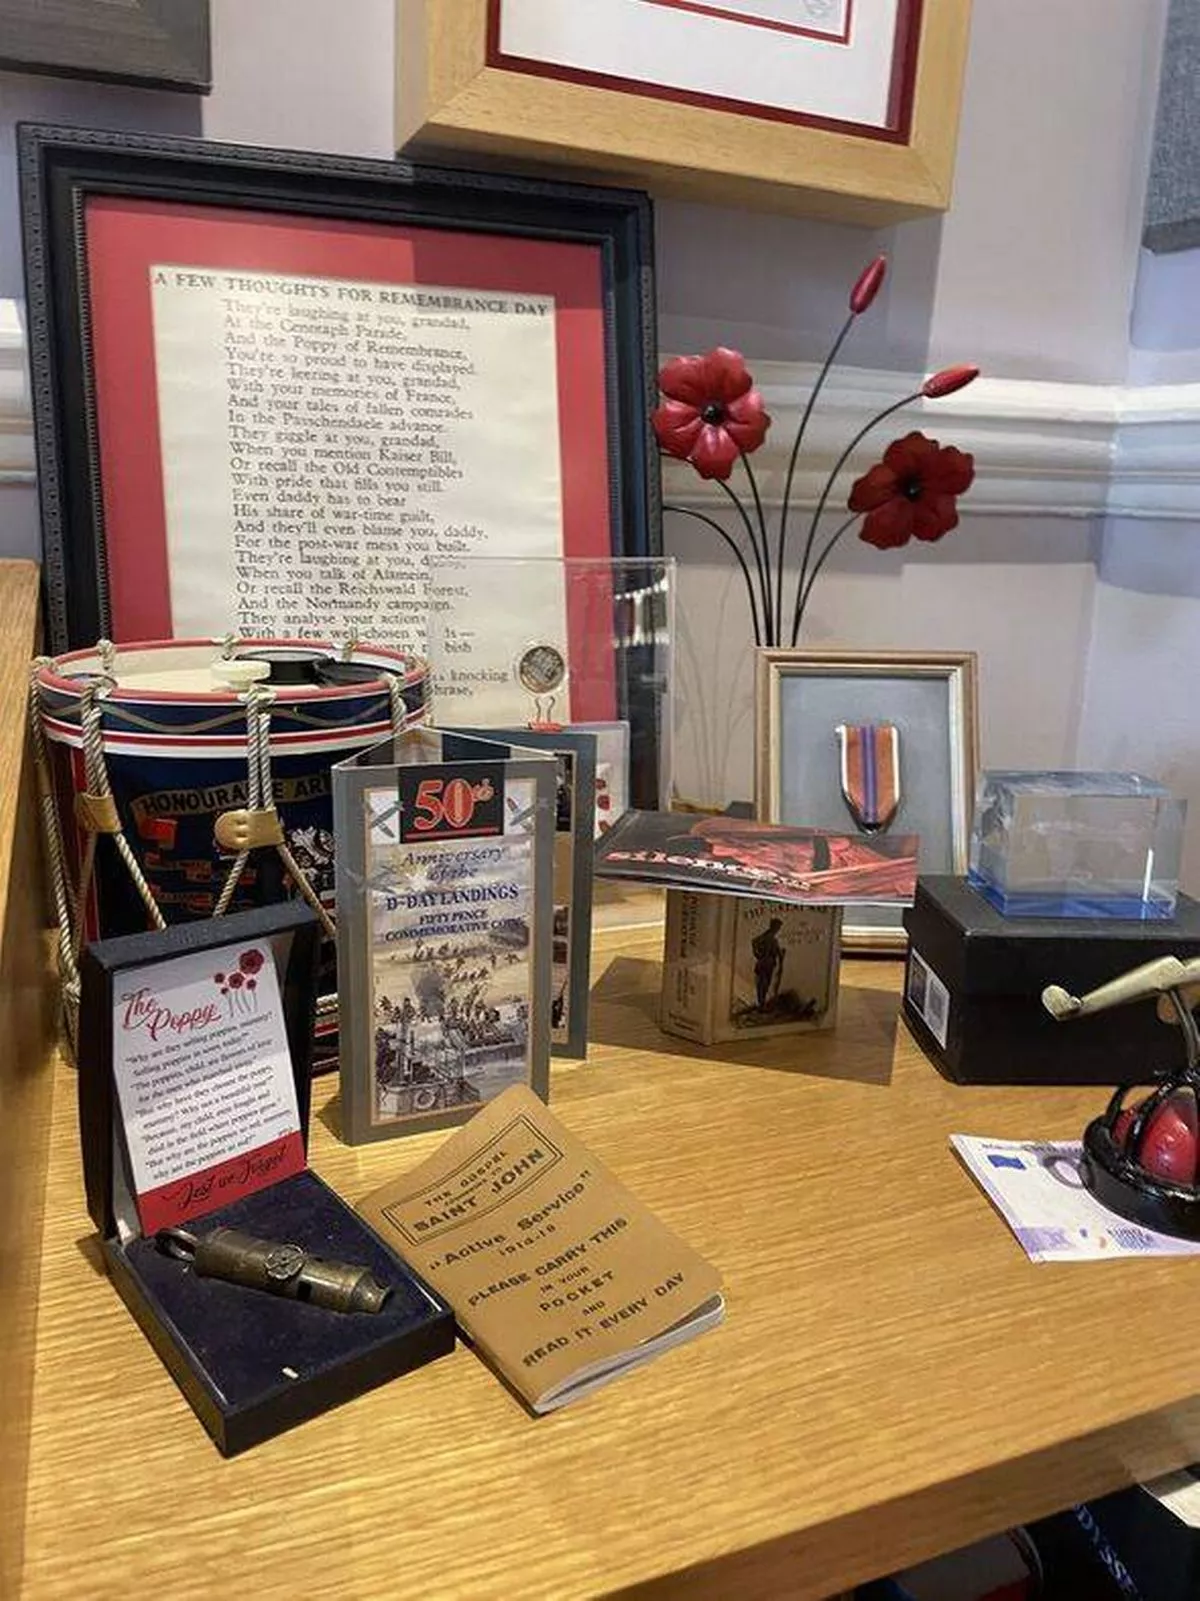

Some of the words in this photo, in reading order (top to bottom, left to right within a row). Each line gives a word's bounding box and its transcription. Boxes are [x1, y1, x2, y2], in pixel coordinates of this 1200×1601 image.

[155, 273, 168, 285] A
[175, 274, 217, 288] FEW
[223, 277, 331, 298] THOUGHTS
[337, 287, 373, 302] FOR
[379, 290, 509, 314] REMEMBRANCE
[514, 302, 549, 316] DAY
[292, 335, 335, 353] Poppy
[344, 338, 359, 352] of
[304, 351, 345, 369] proud
[353, 355, 367, 368] to
[374, 355, 405, 370] have
[227, 377, 264, 393] With
[270, 384, 302, 397] your
[311, 383, 378, 398] memories
[384, 385, 398, 399] of
[227, 393, 258, 408] And
[266, 399, 298, 413] your
[306, 397, 339, 412] tales
[345, 399, 358, 413] of
[366, 400, 403, 415] fallen
[228, 409, 244, 424] In
[252, 410, 276, 425] the
[228, 425, 268, 443] They
[325, 430, 338, 443] at
[229, 441, 272, 456] When
[280, 447, 306, 460] you
[313, 446, 371, 459] mention
[379, 446, 421, 461] Kaiser
[230, 456, 250, 471] Or
[258, 457, 297, 472] recall
[304, 459, 326, 473] the
[332, 460, 359, 474] Old
[231, 472, 268, 487] With
[275, 473, 311, 490] pride
[319, 475, 347, 489] that
[384, 481, 409, 493] you
[232, 487, 268, 502] Even
[276, 489, 319, 506] daddy
[327, 490, 350, 504] has
[356, 492, 370, 504] to
[233, 503, 258, 517] His
[266, 504, 303, 518] share
[310, 505, 324, 518] of
[234, 519, 264, 533] And
[272, 520, 316, 536] they'll
[323, 525, 355, 534] even
[362, 521, 402, 535] blame
[234, 534, 261, 548] For
[268, 534, 291, 548] the
[365, 540, 398, 550] mess
[404, 541, 429, 553] you
[235, 549, 292, 567] They're
[300, 550, 360, 567] laughing
[366, 553, 379, 565] at
[235, 565, 279, 578] When
[286, 570, 312, 582] you
[320, 566, 345, 579] talk
[352, 566, 364, 579] of
[236, 580, 255, 594] Or
[264, 581, 302, 594] recall
[310, 581, 332, 594] the
[238, 595, 268, 609] And
[277, 595, 298, 609] the
[306, 596, 378, 612] Normandy
[238, 610, 276, 627] They
[284, 610, 335, 626] analyse
[342, 614, 372, 626] your
[239, 626, 275, 638] With
[298, 626, 322, 638] few
[143, 783, 283, 813] HONOURAE
[401, 847, 506, 868] Anniversary
[387, 890, 438, 911] D-DAY
[440, 883, 519, 907] LANDINGS
[419, 912, 450, 925] FIFTY
[451, 909, 488, 921] PENCE
[385, 920, 491, 942] COMMEMORATIVE
[121, 988, 158, 1030] The
[148, 1003, 222, 1041] Poppy
[460, 1151, 509, 1188] GOSPEL
[413, 1196, 478, 1232] SAINT
[491, 1149, 544, 1194] JOHN
[468, 1272, 531, 1308] PLEASE
[535, 1242, 587, 1277] CARRY
[589, 1217, 628, 1246] THIS
[560, 1265, 590, 1284] YOUR
[540, 1270, 614, 1312] POCKET
[582, 1300, 606, 1317] AND
[522, 1335, 569, 1367] READ
[575, 1326, 593, 1341] IT
[599, 1298, 649, 1329] EVERY
[655, 1272, 685, 1297] DAY
